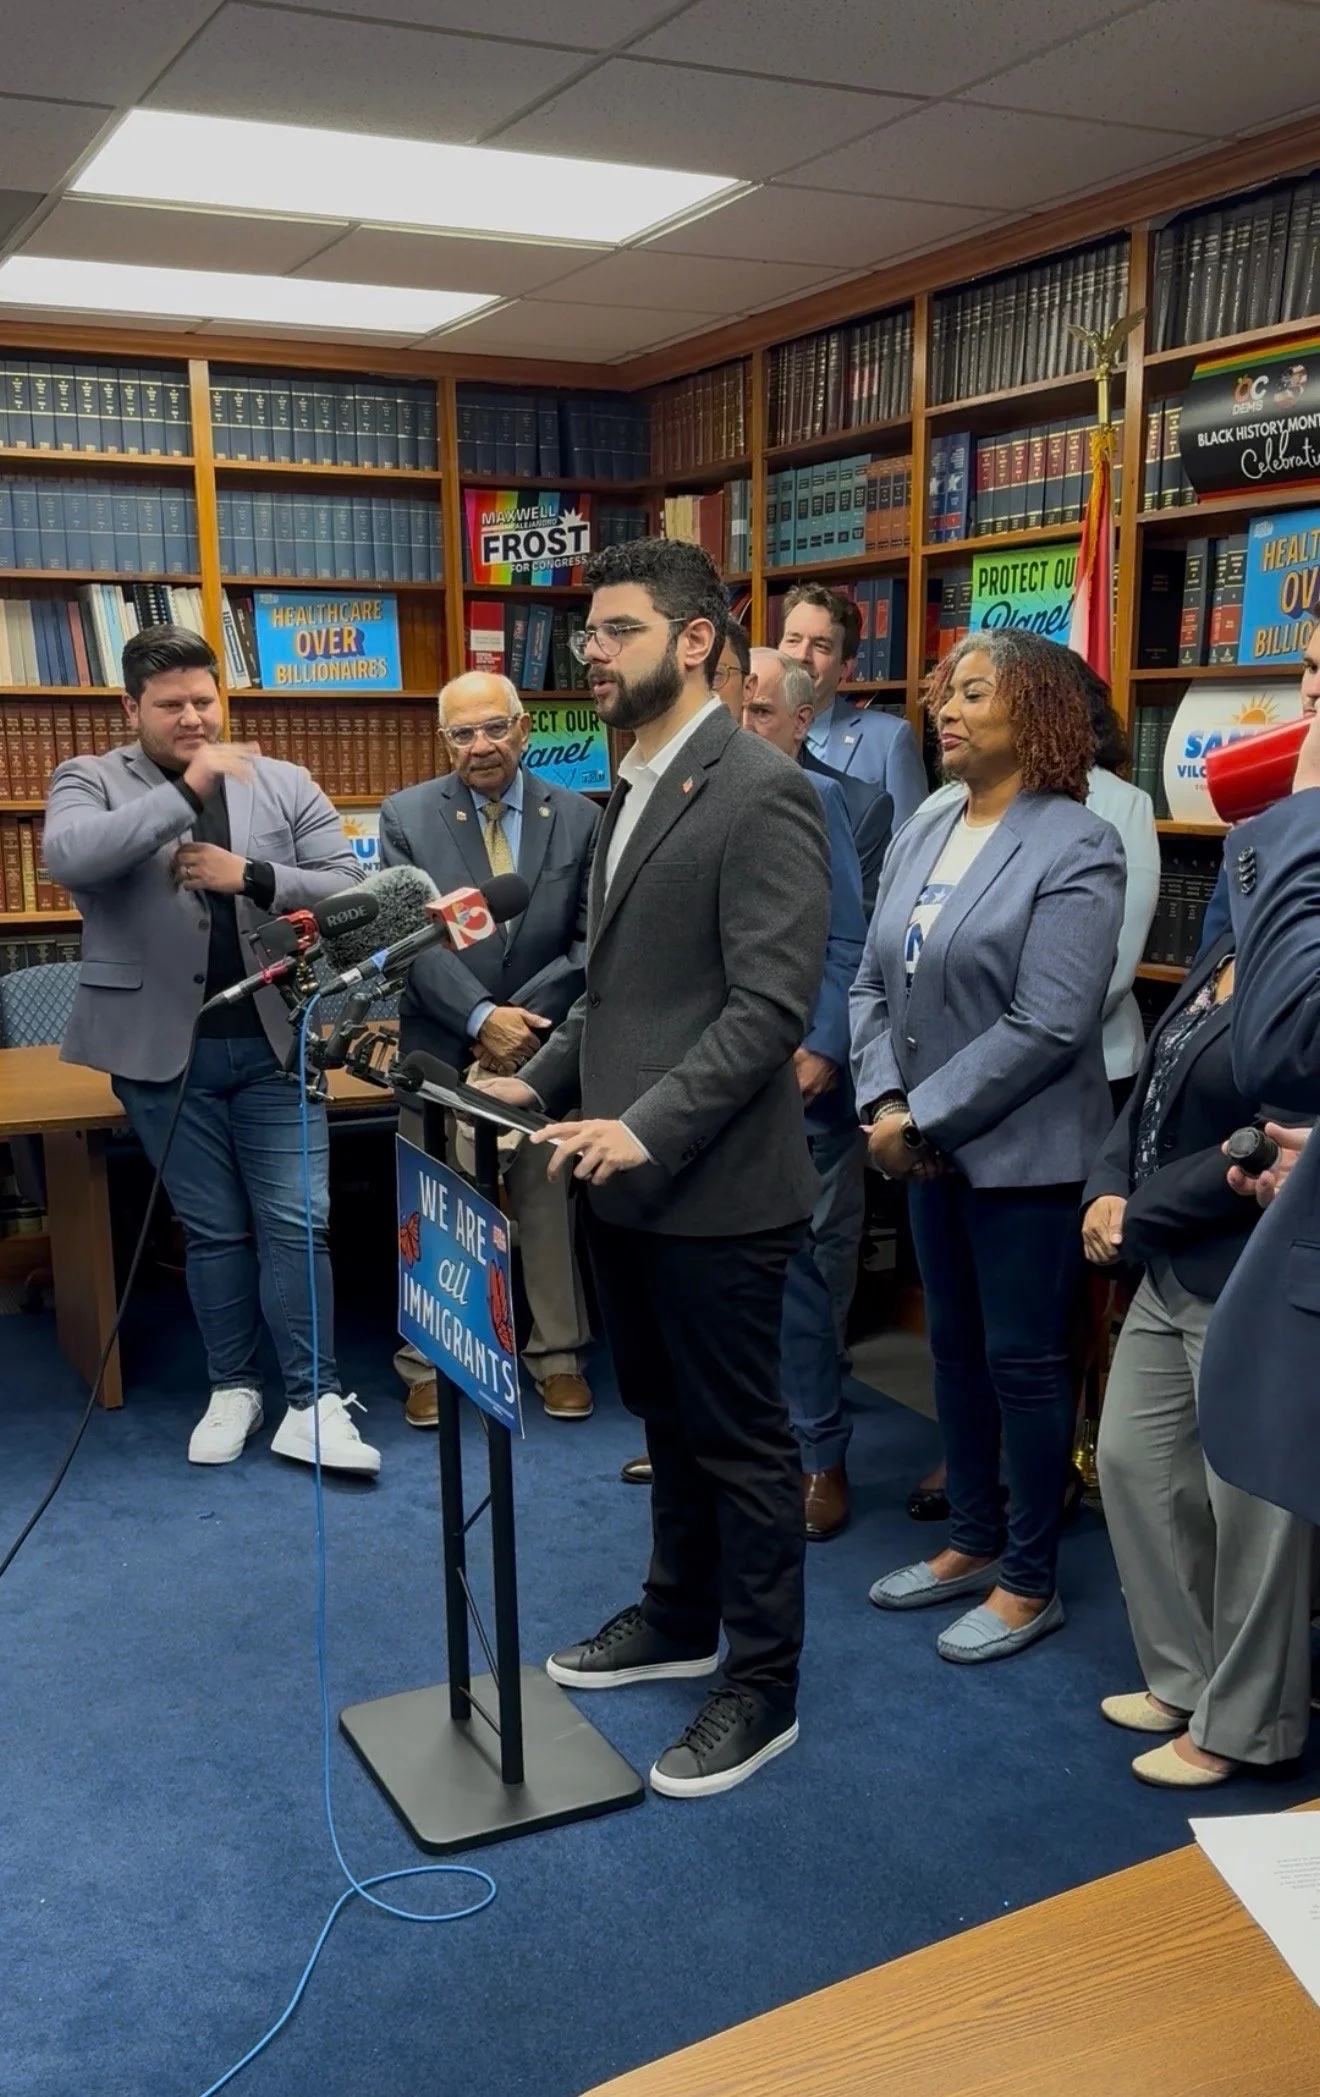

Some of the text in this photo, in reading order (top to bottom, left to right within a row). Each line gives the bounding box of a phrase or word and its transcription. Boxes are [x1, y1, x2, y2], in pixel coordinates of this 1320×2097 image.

[1234, 375, 1269, 402] OC
[1232, 400, 1263, 416] DEMS
[1198, 428, 1234, 447] BLACK
[1236, 419, 1286, 440] HISTORY
[1241, 429, 1320, 479] Celebrati
[482, 505, 556, 525] MAXWELL
[483, 524, 588, 562] FROST
[511, 555, 587, 573] FOR CONGRESS
[978, 556, 1079, 597] PROTECT OU
[1281, 565, 1320, 613] OV
[272, 600, 382, 628] HEALTHCARE
[295, 624, 358, 658] OVER
[1255, 620, 1315, 658] BILLIO
[276, 657, 388, 684] BILLIONAIRES
[565, 710, 600, 732] OUR
[419, 1171, 448, 1232] WE
[456, 1198, 487, 1266] ARE
[438, 1258, 470, 1306] all
[404, 1272, 516, 1405] IMMIGRANTS
